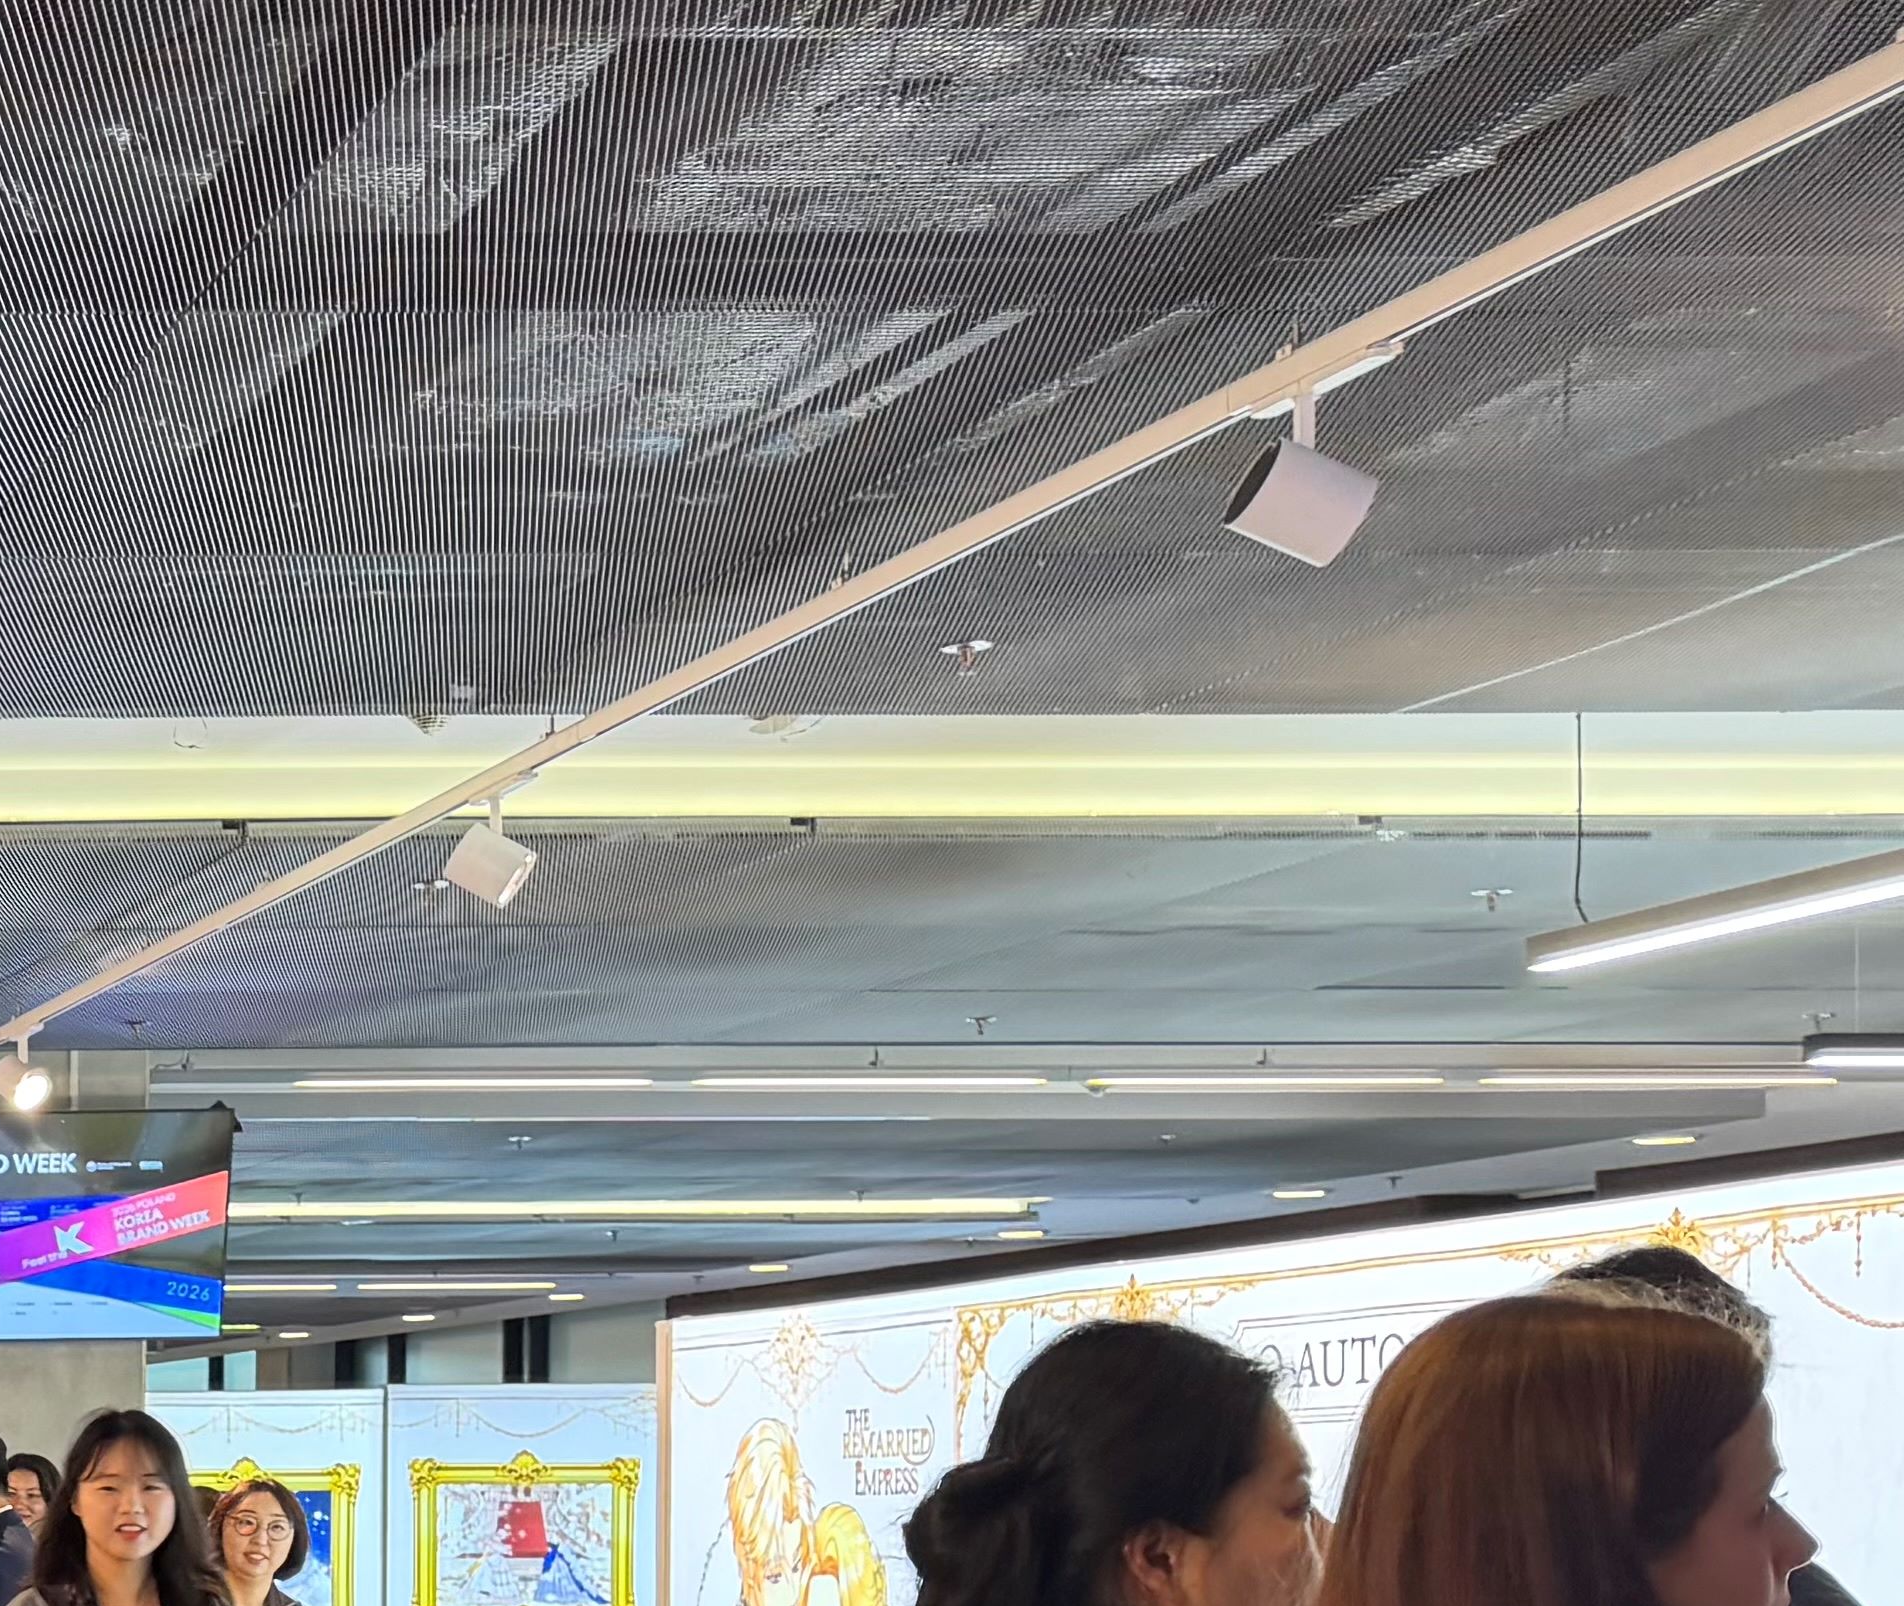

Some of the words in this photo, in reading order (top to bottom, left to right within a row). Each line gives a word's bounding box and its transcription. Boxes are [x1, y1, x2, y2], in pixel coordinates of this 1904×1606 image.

[13, 1153, 77, 1174] WEEK
[114, 1208, 164, 1232] KOREA
[117, 1222, 168, 1247] BRAND
[170, 1209, 210, 1231] WEEK
[166, 1281, 210, 1301] 2026
[845, 1408, 871, 1432] THE
[842, 1426, 934, 1463] REMARRIED
[855, 1464, 919, 1496] EMPRESS
